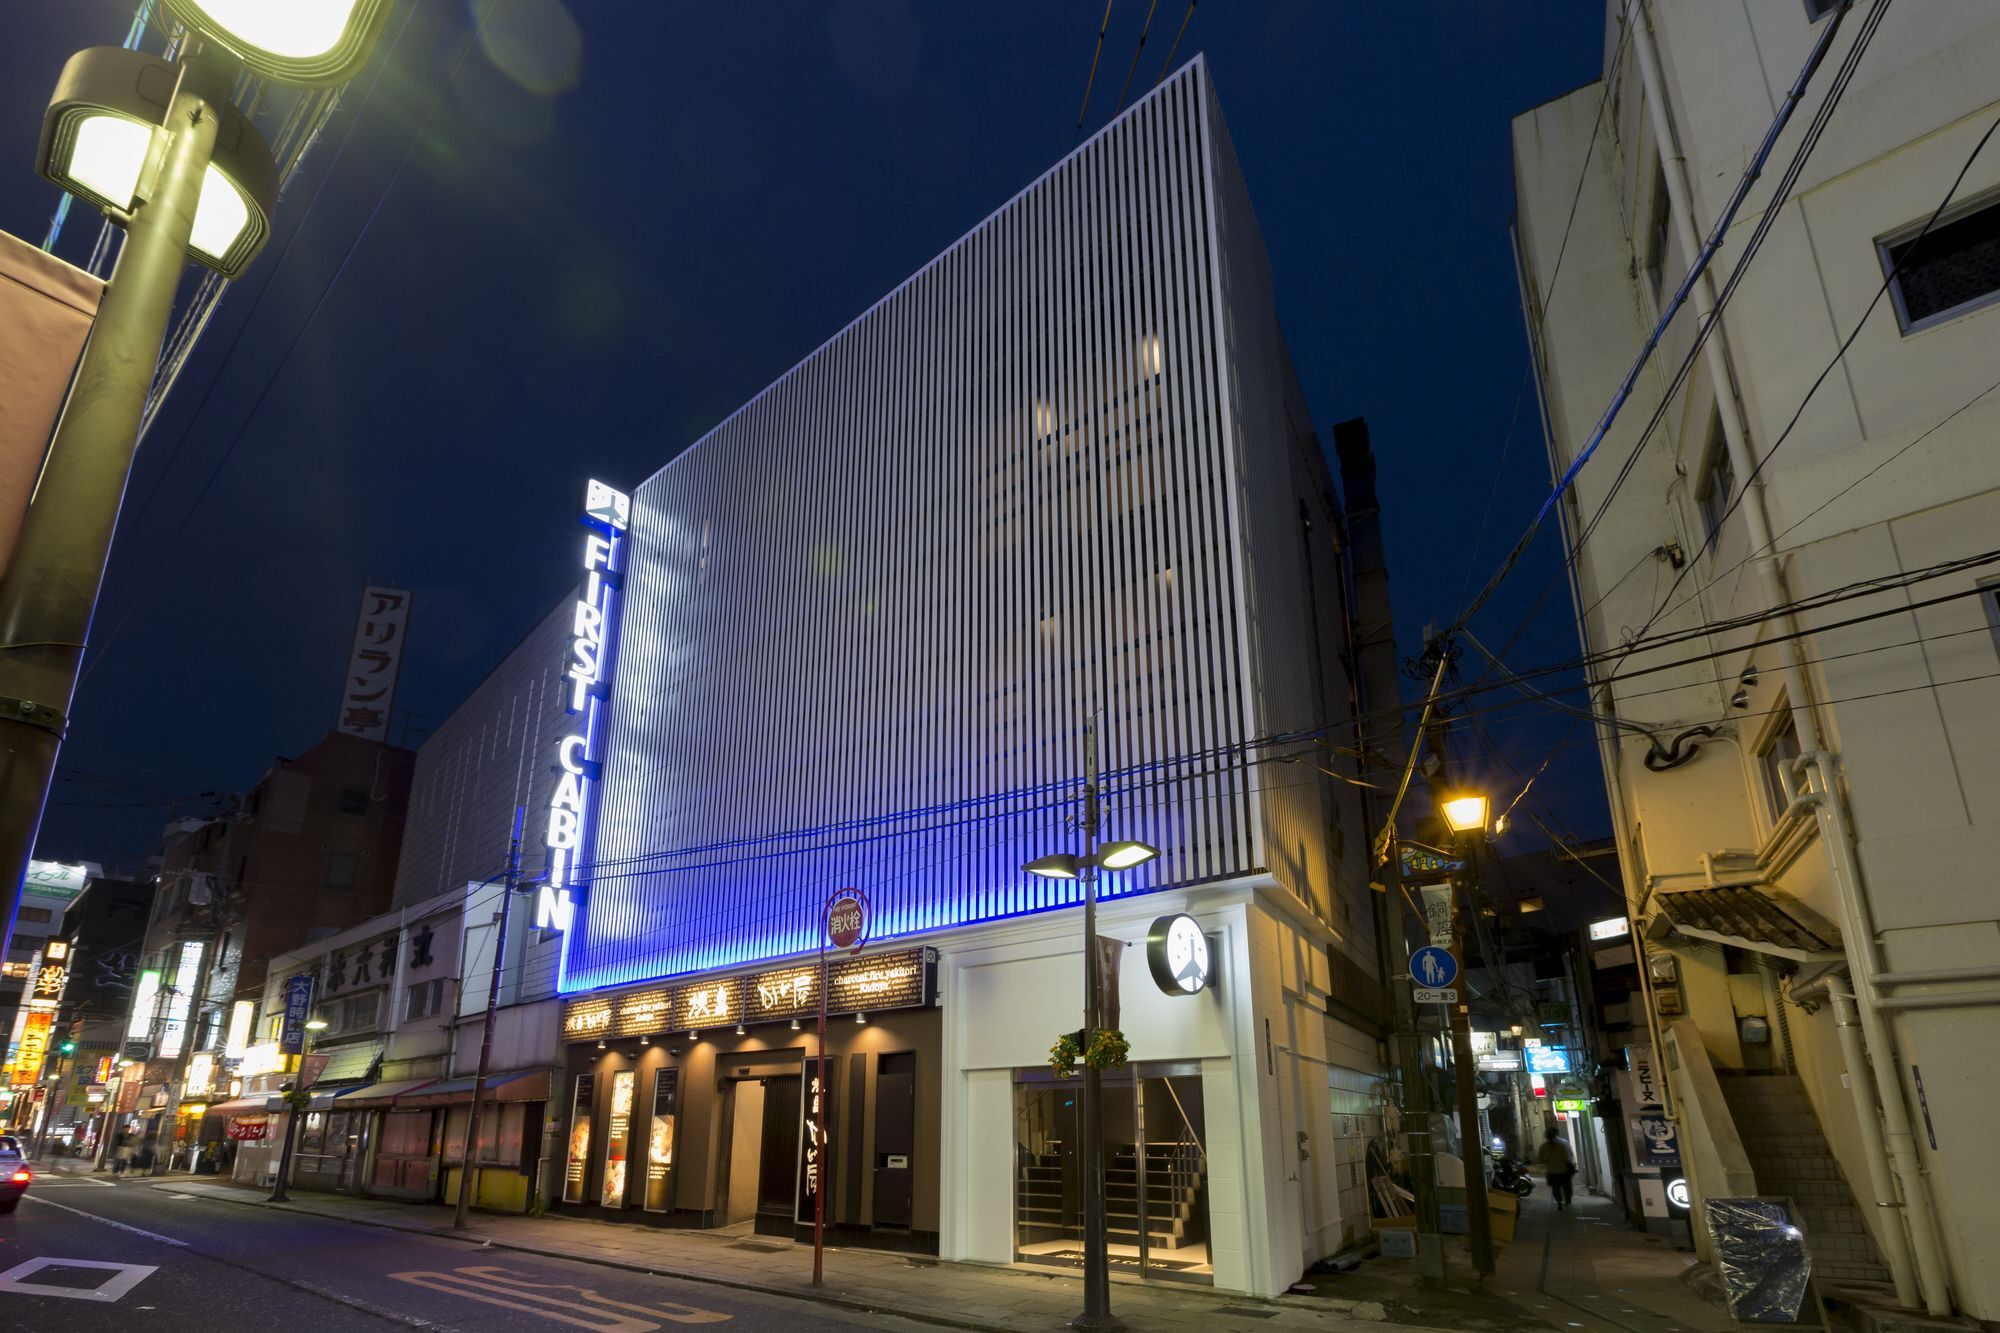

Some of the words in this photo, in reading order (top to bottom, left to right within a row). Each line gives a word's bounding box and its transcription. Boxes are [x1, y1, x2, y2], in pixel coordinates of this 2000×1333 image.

[343, 592, 405, 733] アリラン亭
[569, 534, 610, 713] FIRST
[536, 733, 586, 931] CABIN
[830, 910, 861, 936] 消火栓
